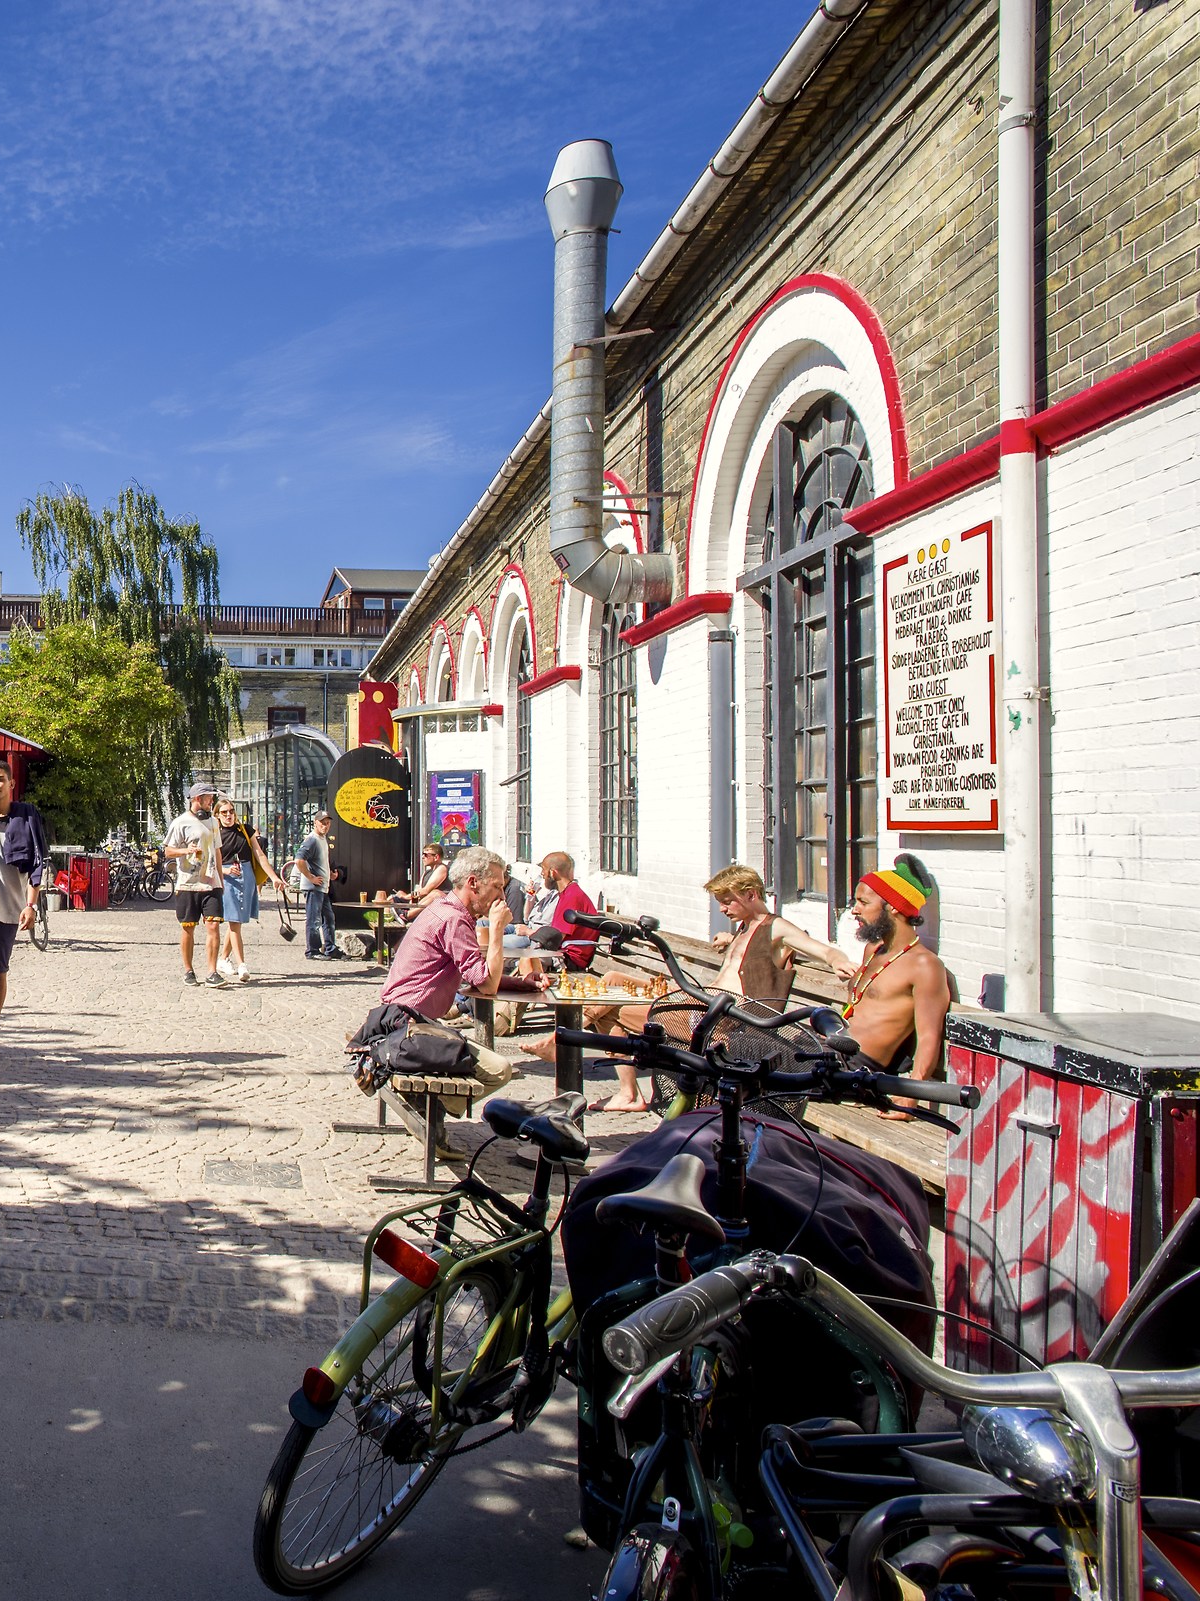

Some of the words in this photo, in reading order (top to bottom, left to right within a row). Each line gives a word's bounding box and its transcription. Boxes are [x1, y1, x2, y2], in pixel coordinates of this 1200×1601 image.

[907, 566, 926, 585] KÆRE
[928, 556, 948, 578] GÆST
[890, 587, 925, 611] VELKOMMEN
[926, 581, 936, 599] TIL
[895, 606, 917, 624] ENESTE
[919, 595, 953, 617] ALKOHOLFRI
[956, 588, 973, 606] CAFE
[895, 619, 924, 640] MEDBRAGT
[925, 615, 940, 631] MAD
[941, 615, 947, 630] &
[948, 605, 972, 625] DRIKKE
[915, 628, 948, 648] FRABEDES
[941, 642, 950, 658] ER
[952, 630, 993, 655] FORBEHOLDT
[908, 660, 942, 681] BETALENDE
[942, 654, 969, 673] KUNDER
[908, 683, 925, 700] DEAR
[925, 677, 949, 697] GUEST
[895, 705, 923, 722] WELCOME
[924, 703, 933, 718] TO
[933, 699, 947, 716] THE
[948, 696, 965, 713] ONLY
[942, 714, 959, 729] CAFE
[961, 712, 969, 727] IN
[892, 752, 906, 768] YOUR
[906, 751, 921, 766] OWN
[921, 749, 937, 764] FOOD
[971, 743, 984, 759] ARE
[920, 762, 956, 778] PROHIBITED
[892, 779, 908, 794] SEATS
[910, 778, 921, 793] ARE
[921, 778, 933, 792] FOR
[934, 776, 959, 792] BUYING
[959, 772, 997, 791] CUSTOMERS
[908, 798, 921, 808] LOVE
